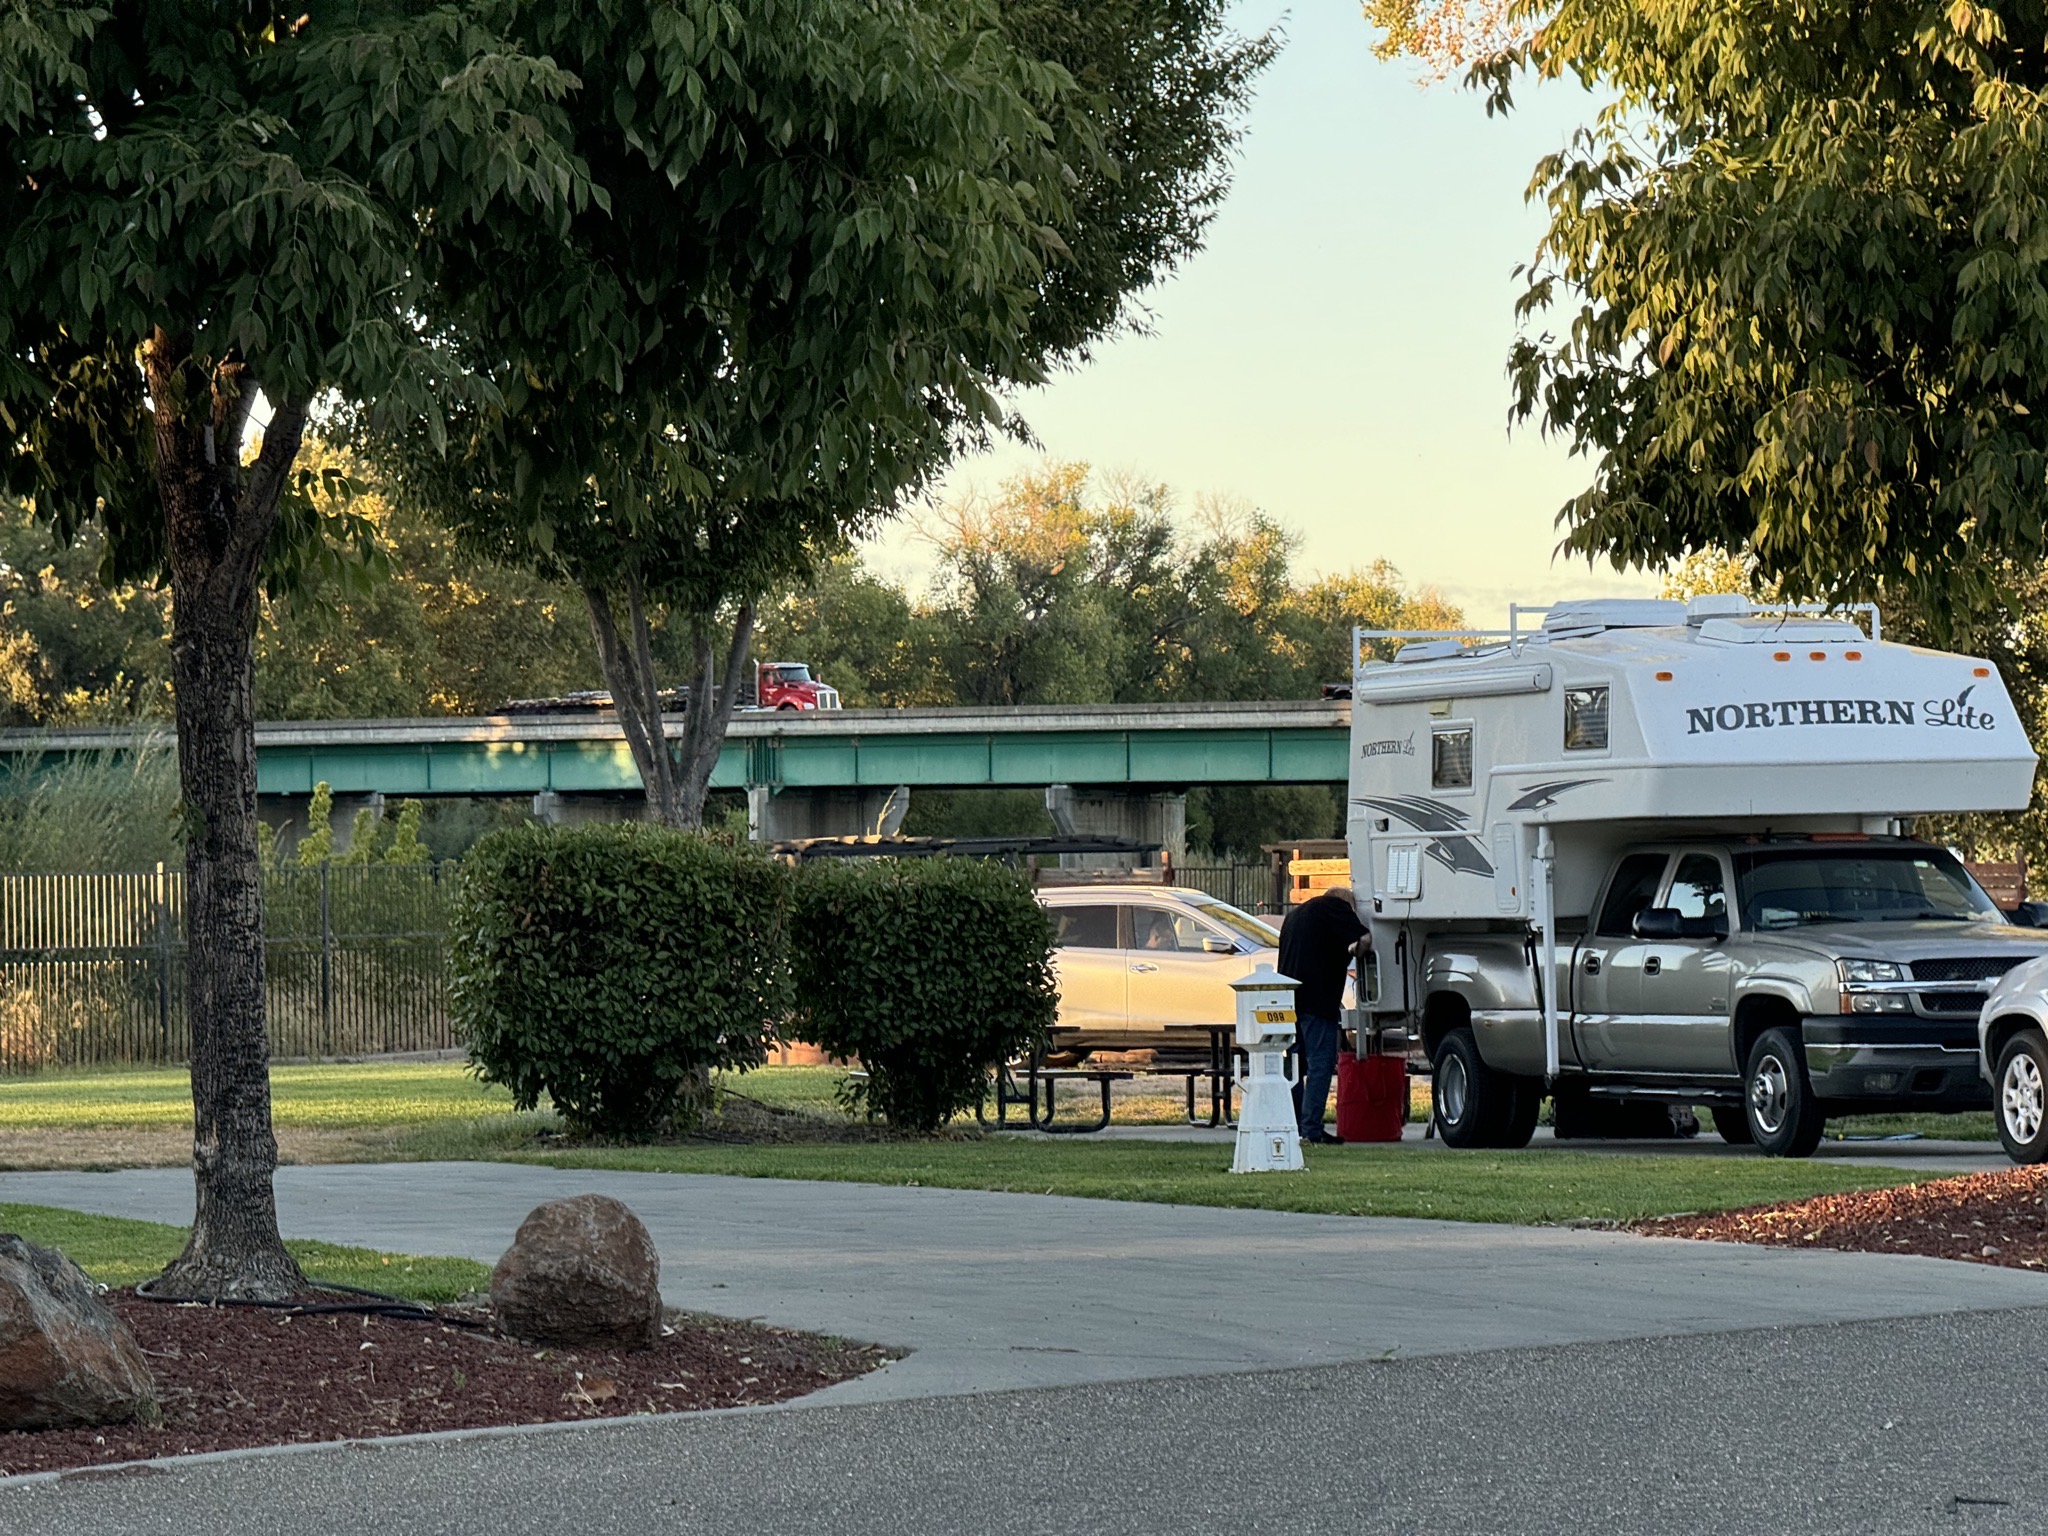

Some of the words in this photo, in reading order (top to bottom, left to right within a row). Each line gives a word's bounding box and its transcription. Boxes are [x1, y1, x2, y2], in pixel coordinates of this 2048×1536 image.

[1686, 700, 1915, 735] NORTHERN
[1923, 685, 1996, 731] Lite
[1361, 740, 1402, 759] NORTHERN
[1267, 1011, 1285, 1022] 098
